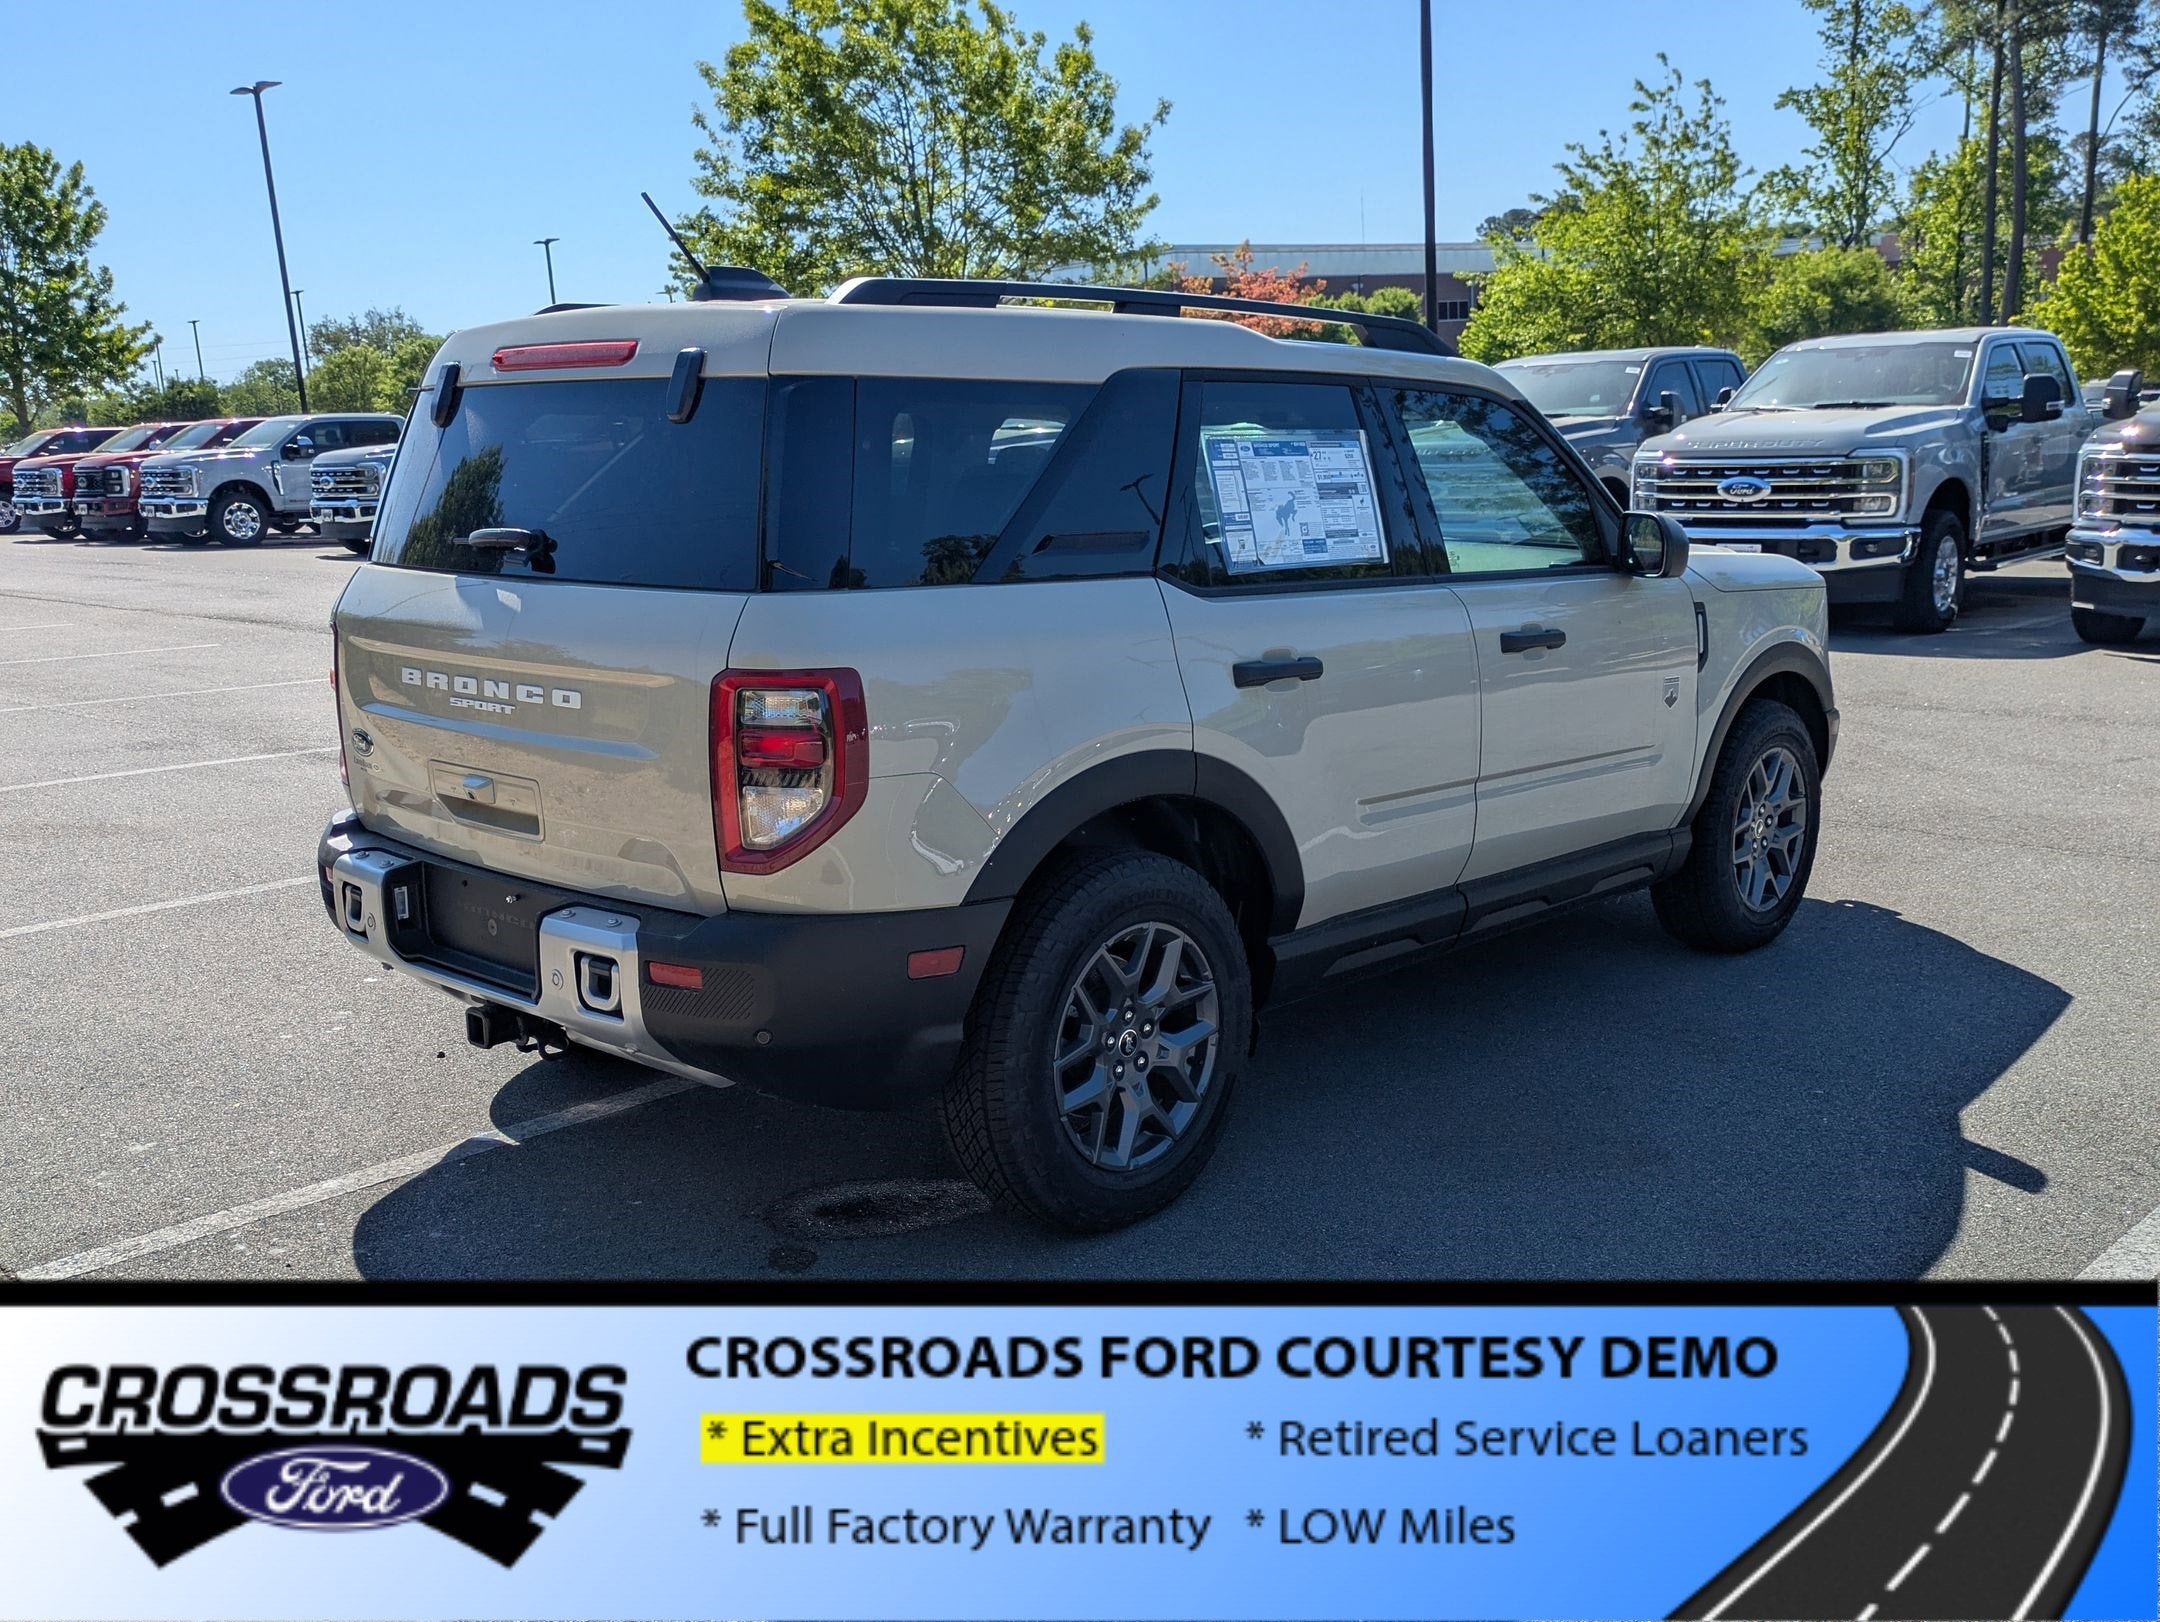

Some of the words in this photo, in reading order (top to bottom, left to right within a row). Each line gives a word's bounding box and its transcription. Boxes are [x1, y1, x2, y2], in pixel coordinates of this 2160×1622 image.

[1729, 483, 1755, 495] Ford
[402, 667, 582, 709] BRONCO
[450, 697, 515, 714] SPORT
